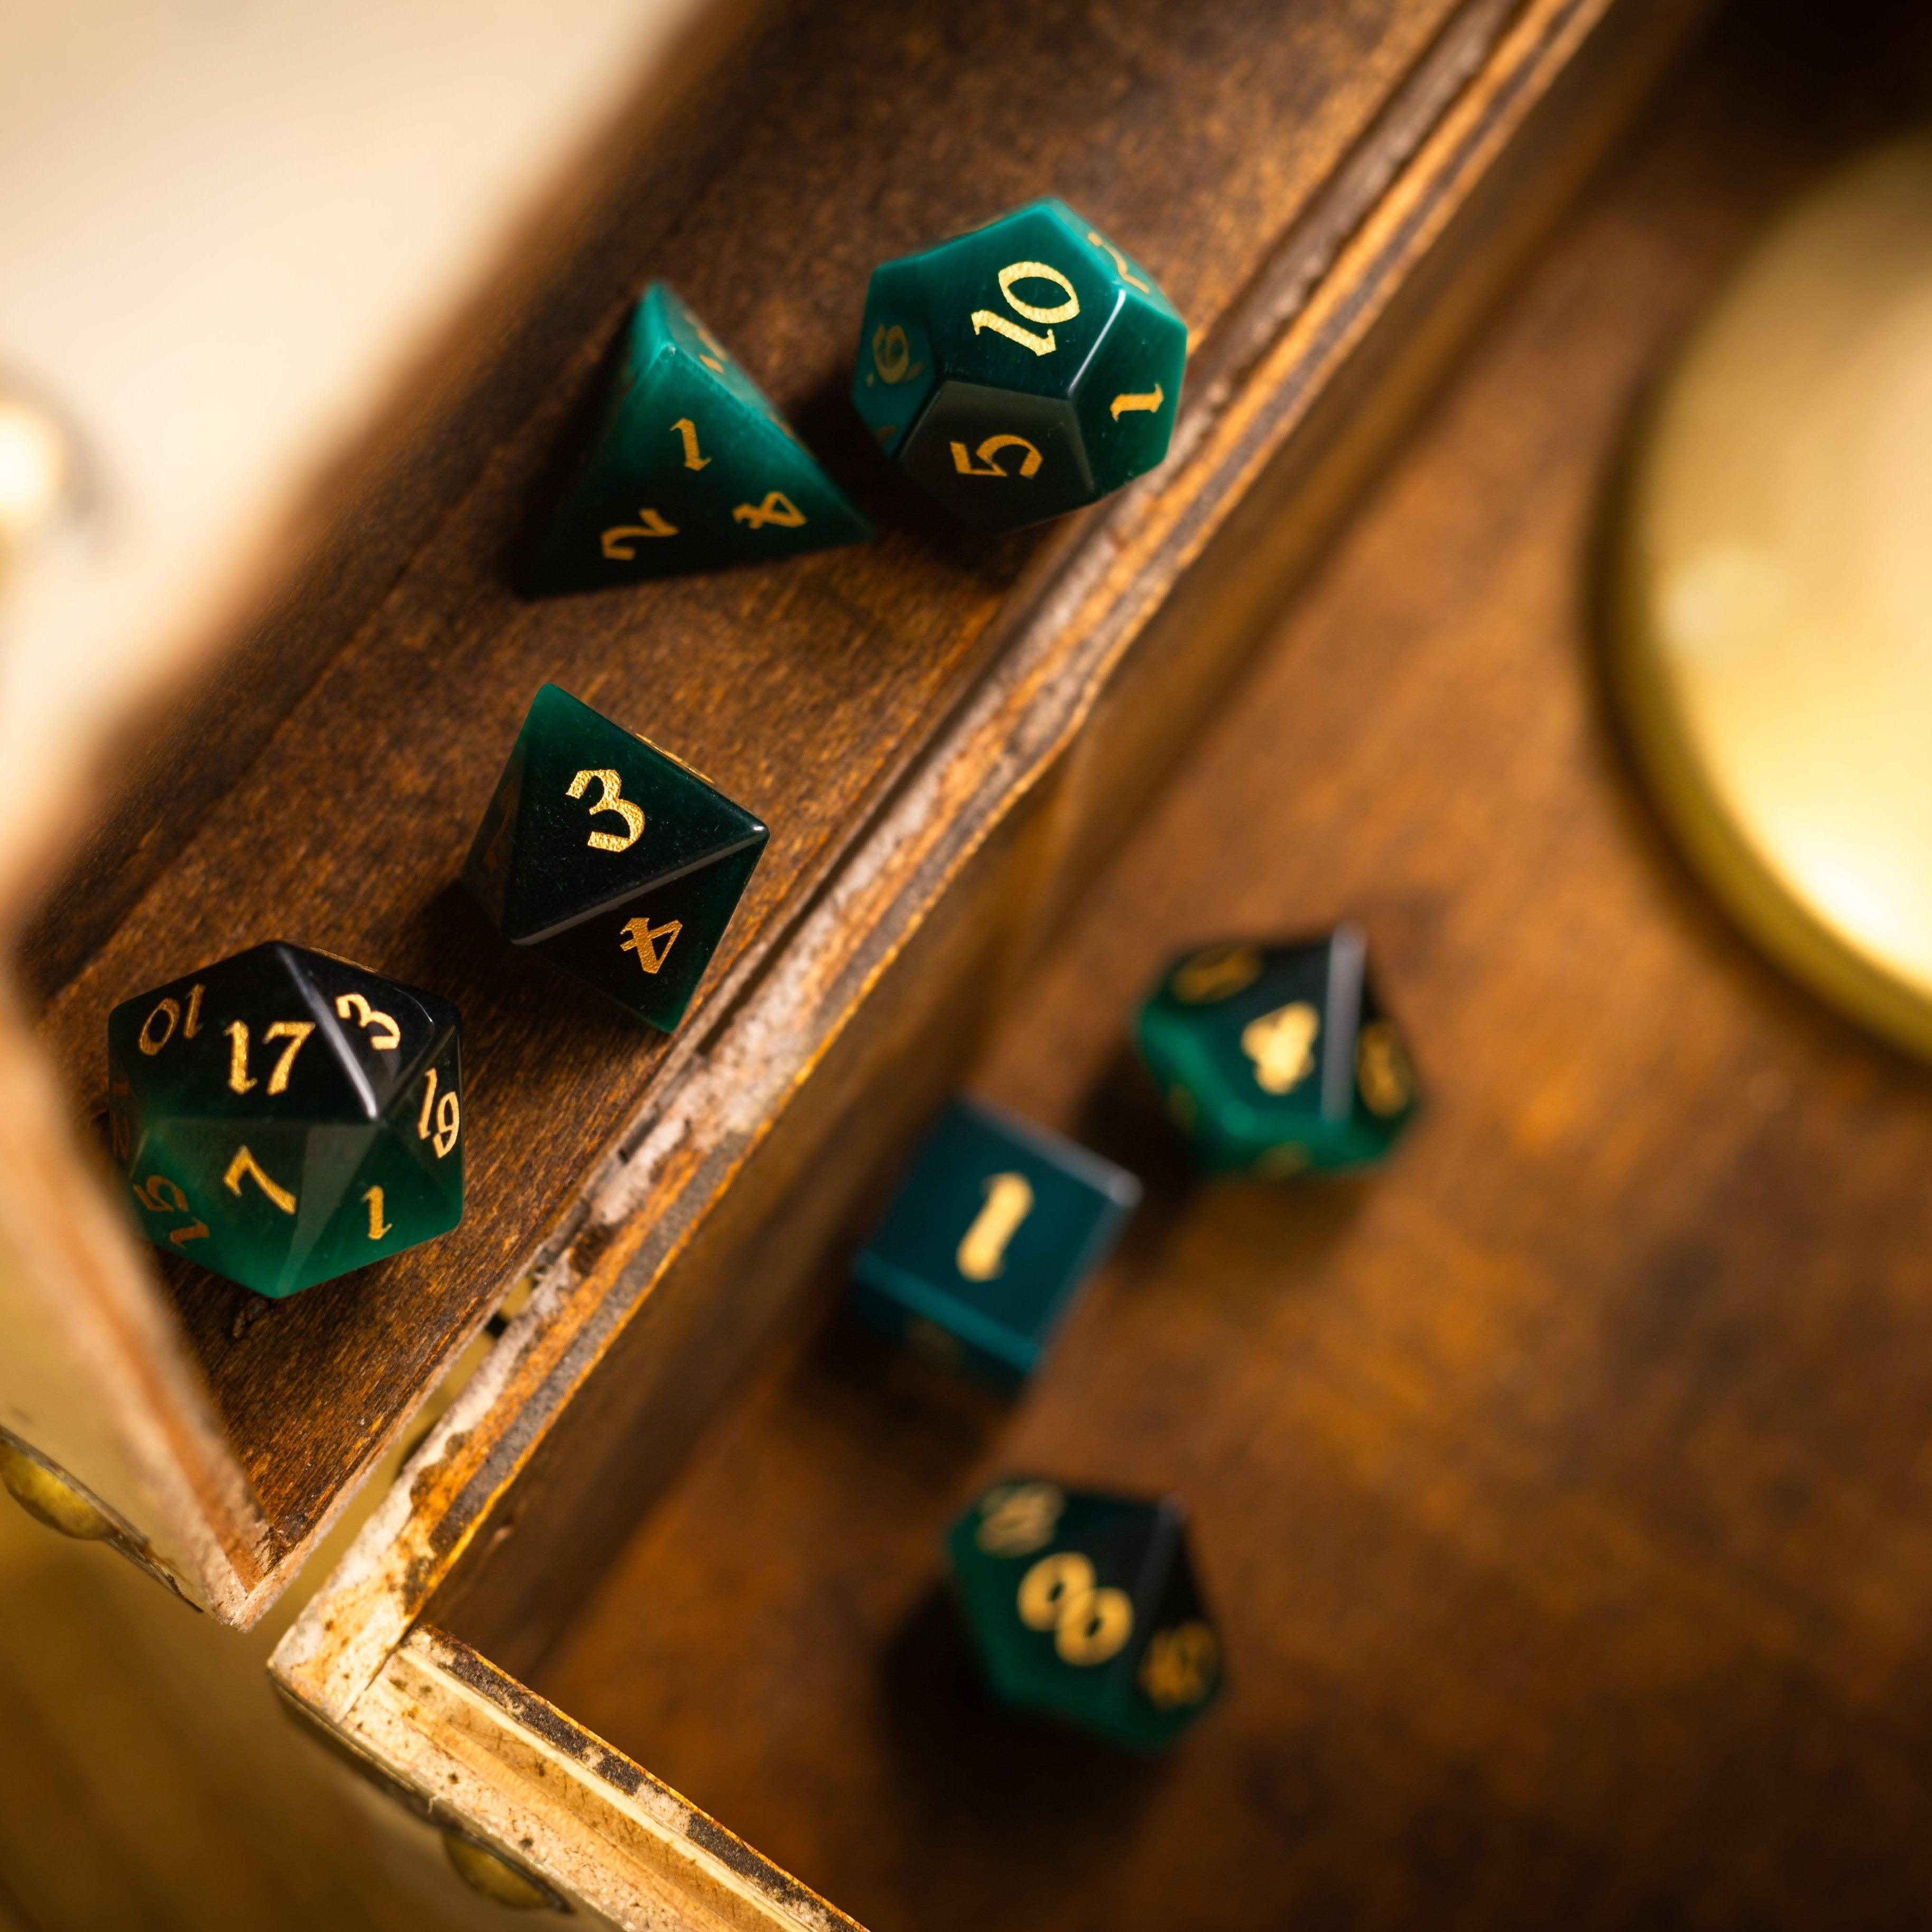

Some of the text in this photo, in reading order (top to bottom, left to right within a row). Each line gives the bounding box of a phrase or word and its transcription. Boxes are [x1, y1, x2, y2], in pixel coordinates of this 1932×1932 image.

[971, 261, 1080, 356] 10
[1110, 383, 1163, 421] 1
[670, 419, 711, 471] 1
[950, 434, 1043, 479] 5
[601, 509, 679, 560] 2
[732, 492, 806, 529] 4
[566, 770, 645, 852] 3
[620, 918, 682, 974] 4
[335, 994, 400, 1050] 3
[224, 1020, 316, 1096] 17
[224, 1145, 297, 1215] 7
[360, 1185, 392, 1240] 1
[958, 1173, 1033, 1280] 1
